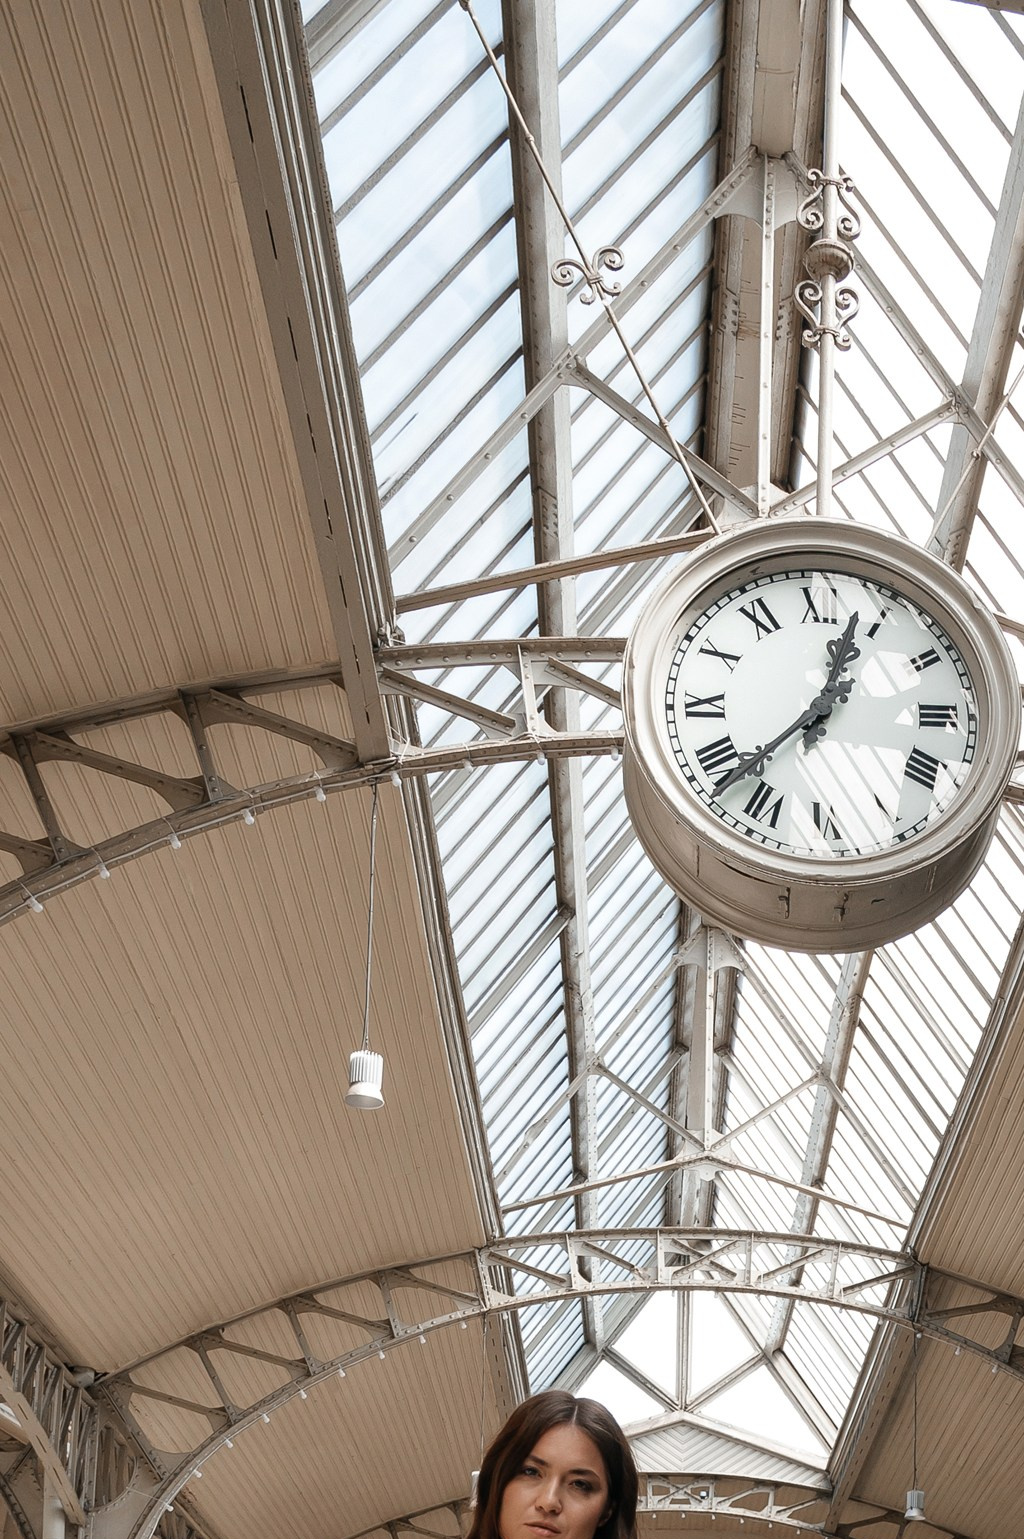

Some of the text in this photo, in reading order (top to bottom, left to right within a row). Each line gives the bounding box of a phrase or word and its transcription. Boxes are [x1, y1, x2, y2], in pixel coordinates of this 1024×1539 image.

[737, 596, 784, 642] XI
[799, 586, 839, 625] XII
[698, 637, 743, 674] X
[684, 690, 727, 721] IX
[917, 702, 958, 731] III
[742, 778, 785, 830] VII
